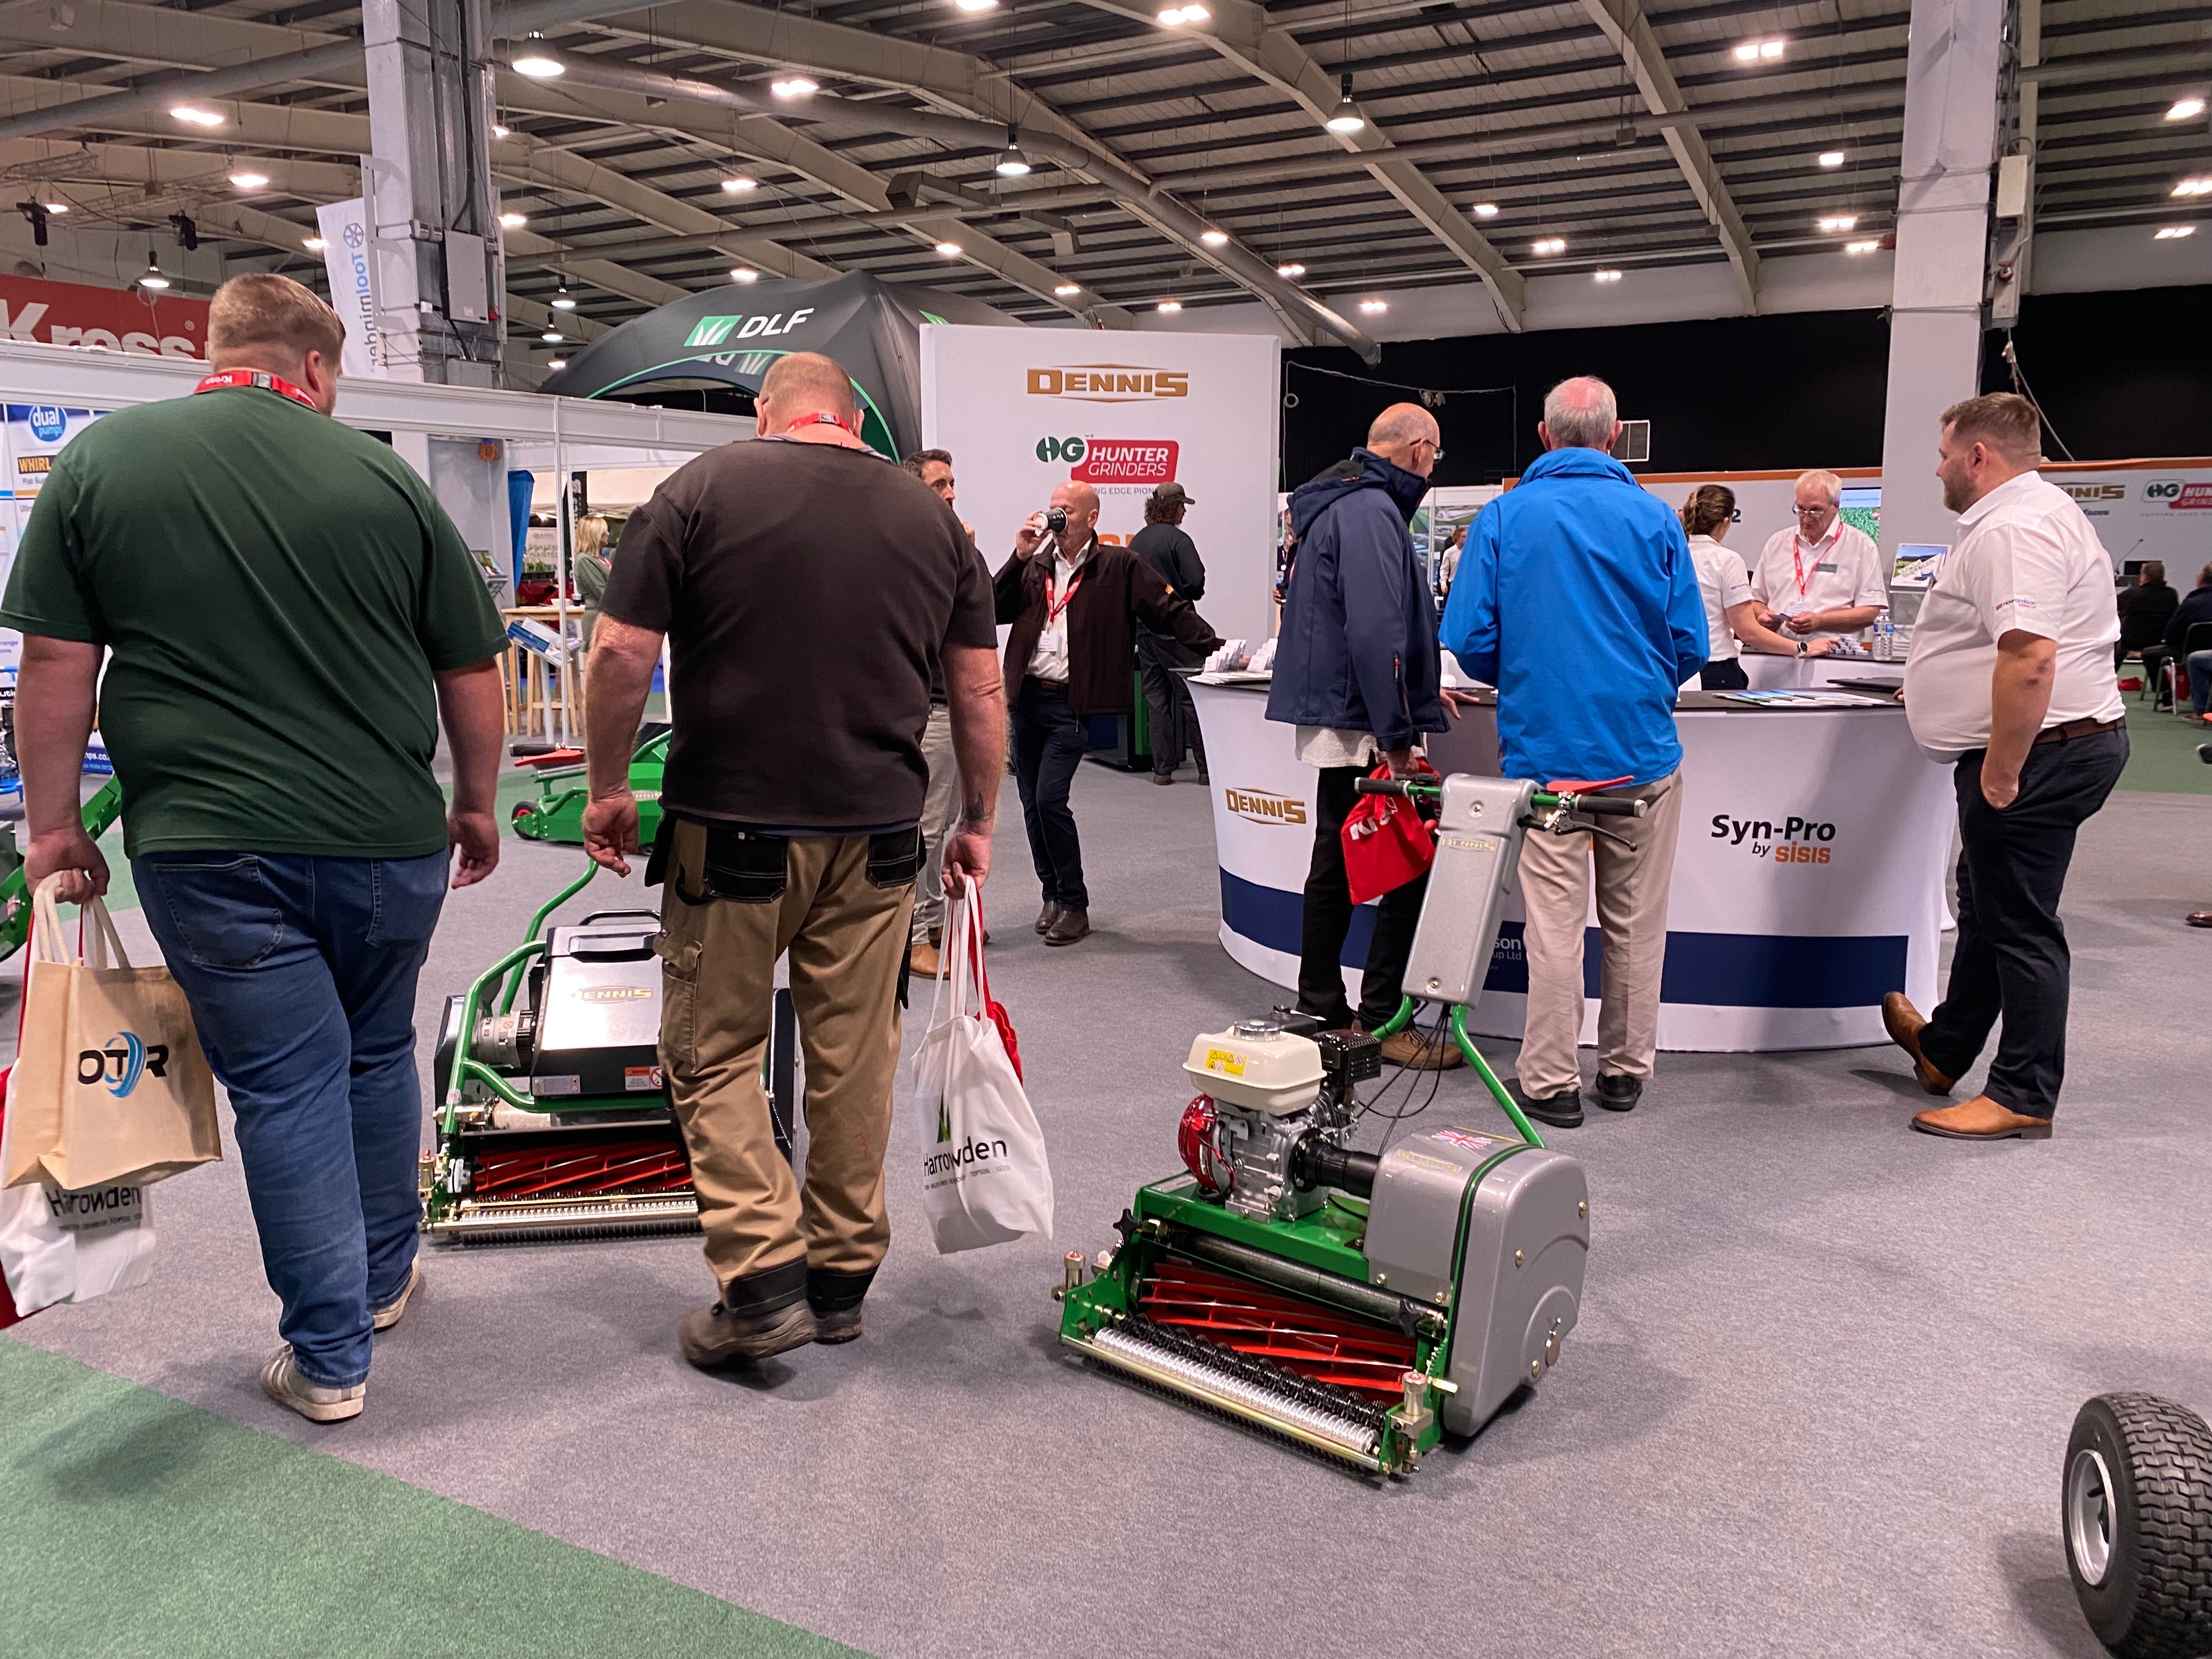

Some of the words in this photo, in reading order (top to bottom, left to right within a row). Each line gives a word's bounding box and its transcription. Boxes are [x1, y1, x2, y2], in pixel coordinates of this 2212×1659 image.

[736, 308, 815, 338] DLF
[1027, 369, 1189, 397] DENNIS
[32, 406, 60, 427] dual
[1091, 447, 1169, 462] HUNTER
[1088, 462, 1167, 477] GRINDERS
[1225, 788, 1307, 824] DENNIS
[1711, 814, 1836, 845] Syn-Pro
[1752, 841, 1771, 858] by
[1506, 951, 1522, 961] Ltd
[579, 988, 652, 1000] ENNIS
[77, 1045, 169, 1085] OTR
[923, 1136, 1008, 1177] Harrowden
